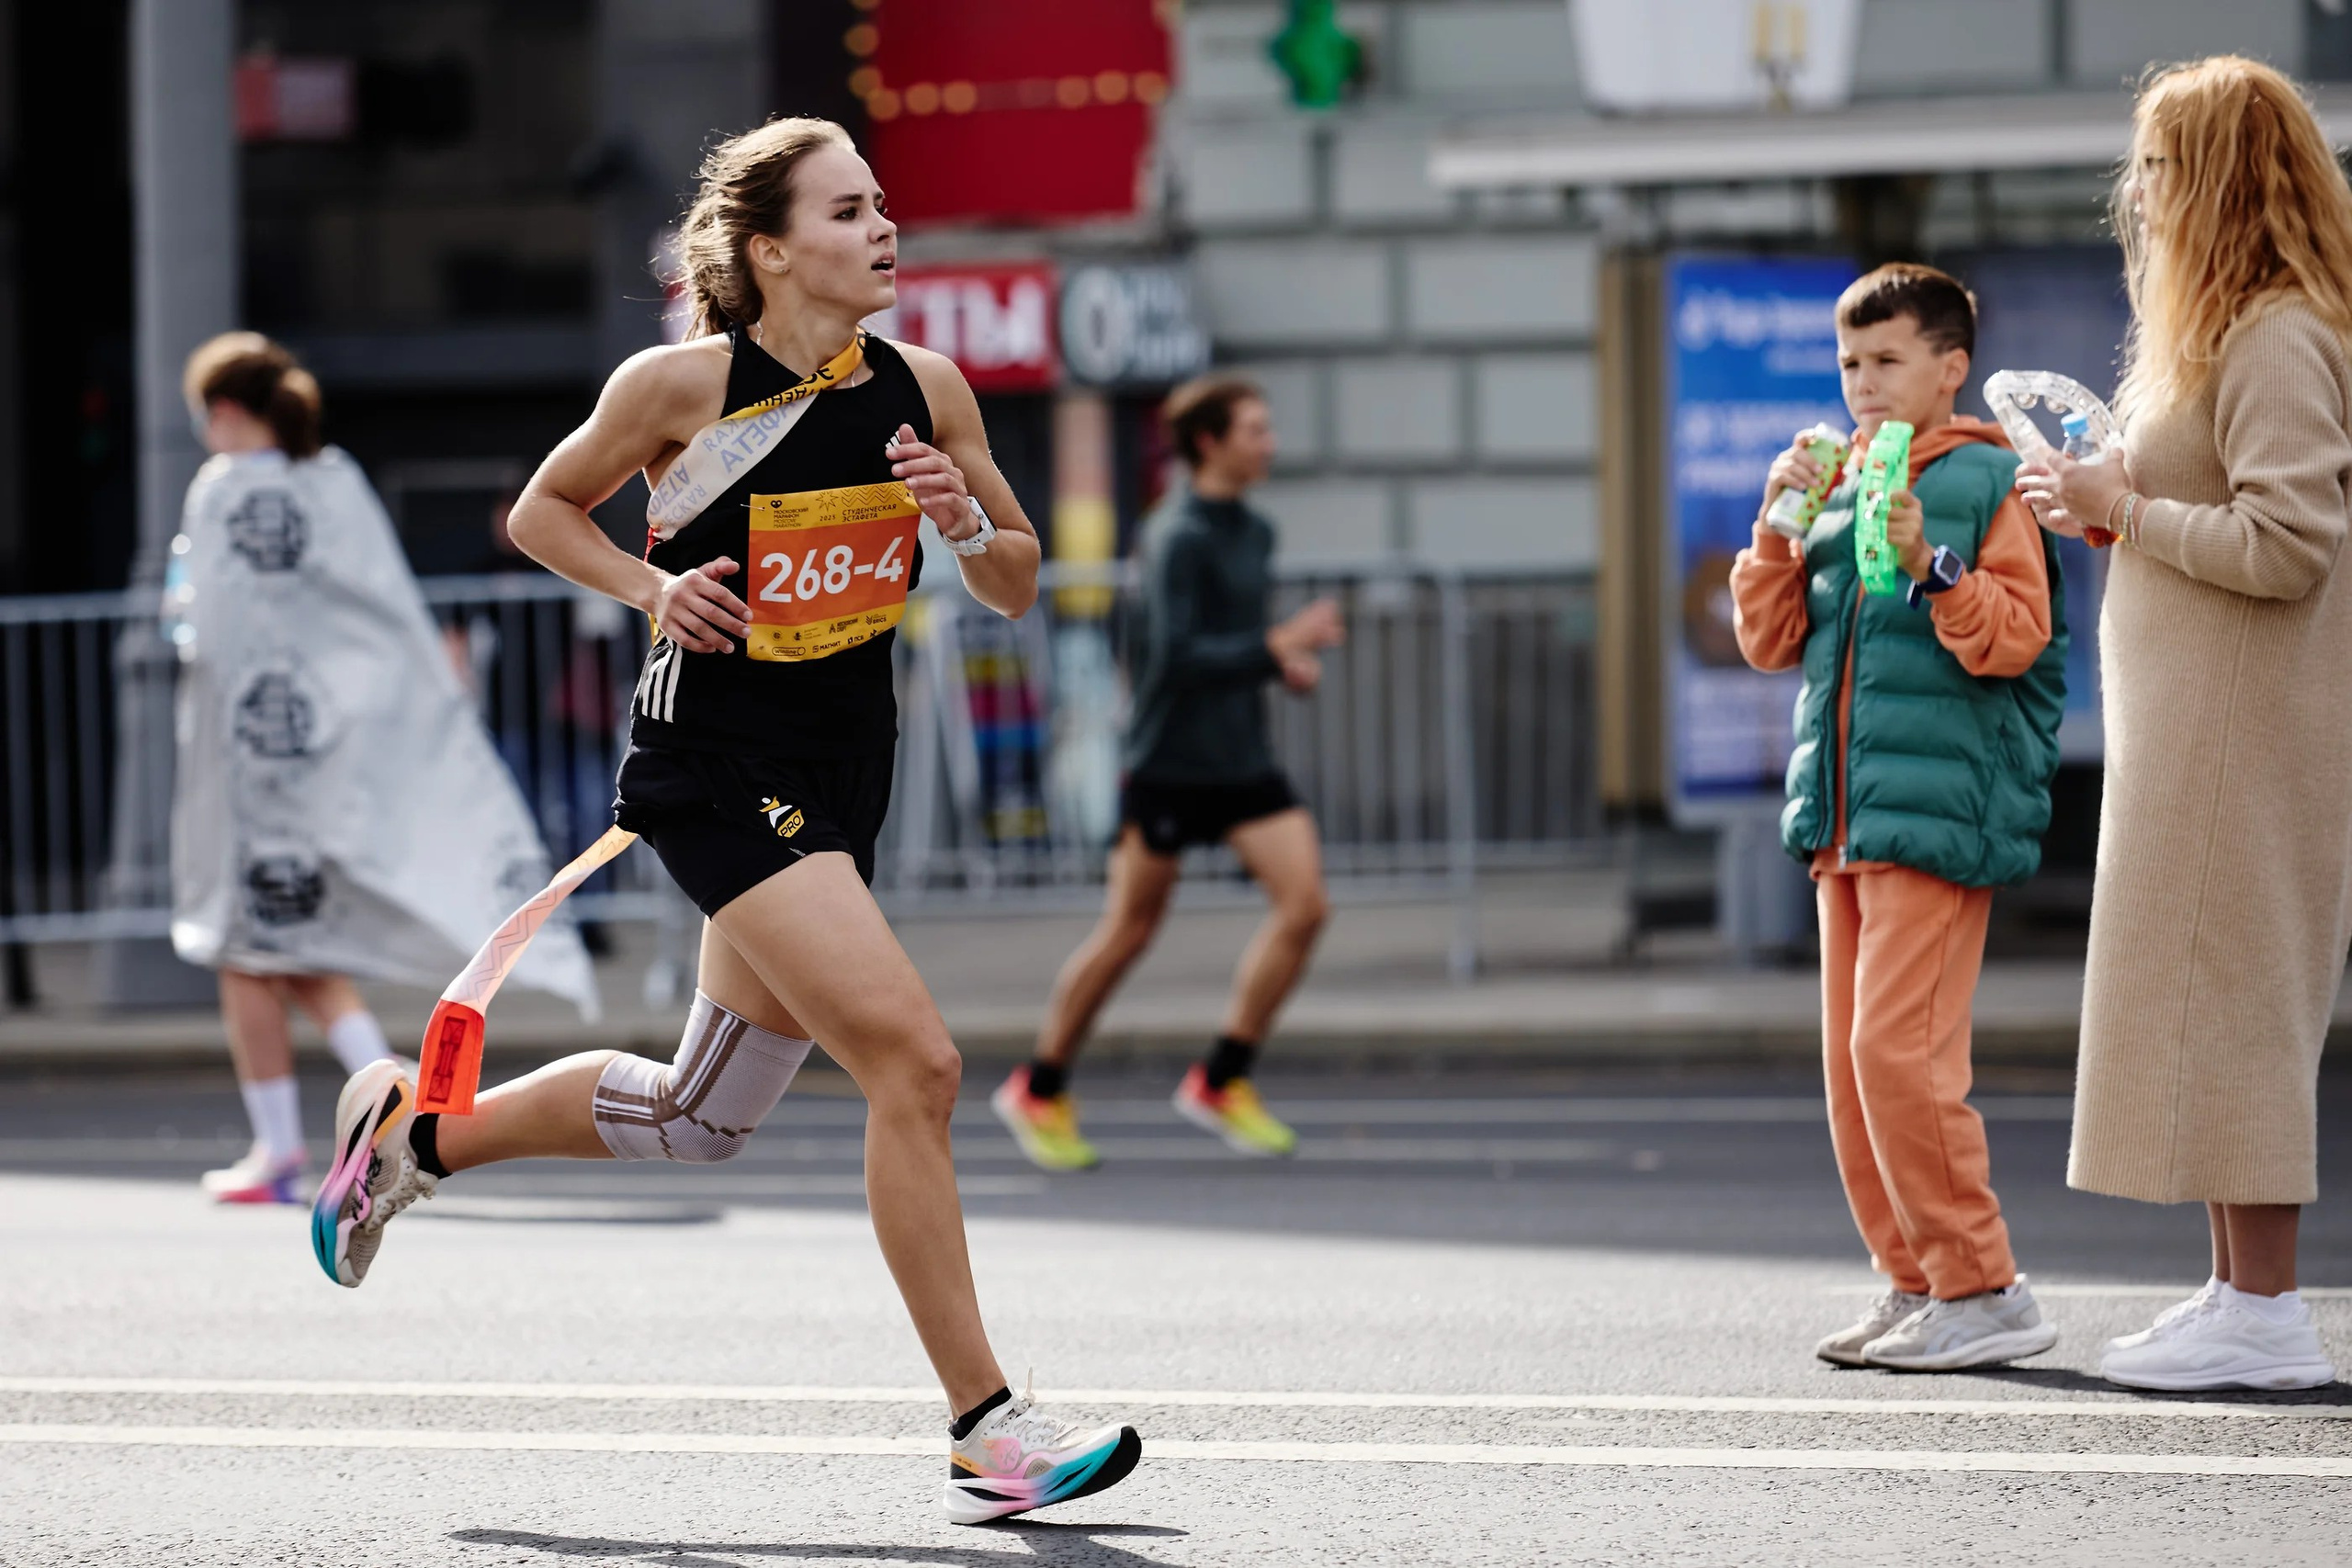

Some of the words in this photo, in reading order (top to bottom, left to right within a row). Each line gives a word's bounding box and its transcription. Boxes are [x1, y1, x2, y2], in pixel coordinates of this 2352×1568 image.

[842, 503, 897, 516] СТУДЕНЧЕСКАЯ
[842, 513, 878, 523] ЭСТАФЕТА
[759, 536, 904, 603] 268-4
[820, 640, 841, 650] МАГНИТ
[780, 815, 801, 837] PRO
